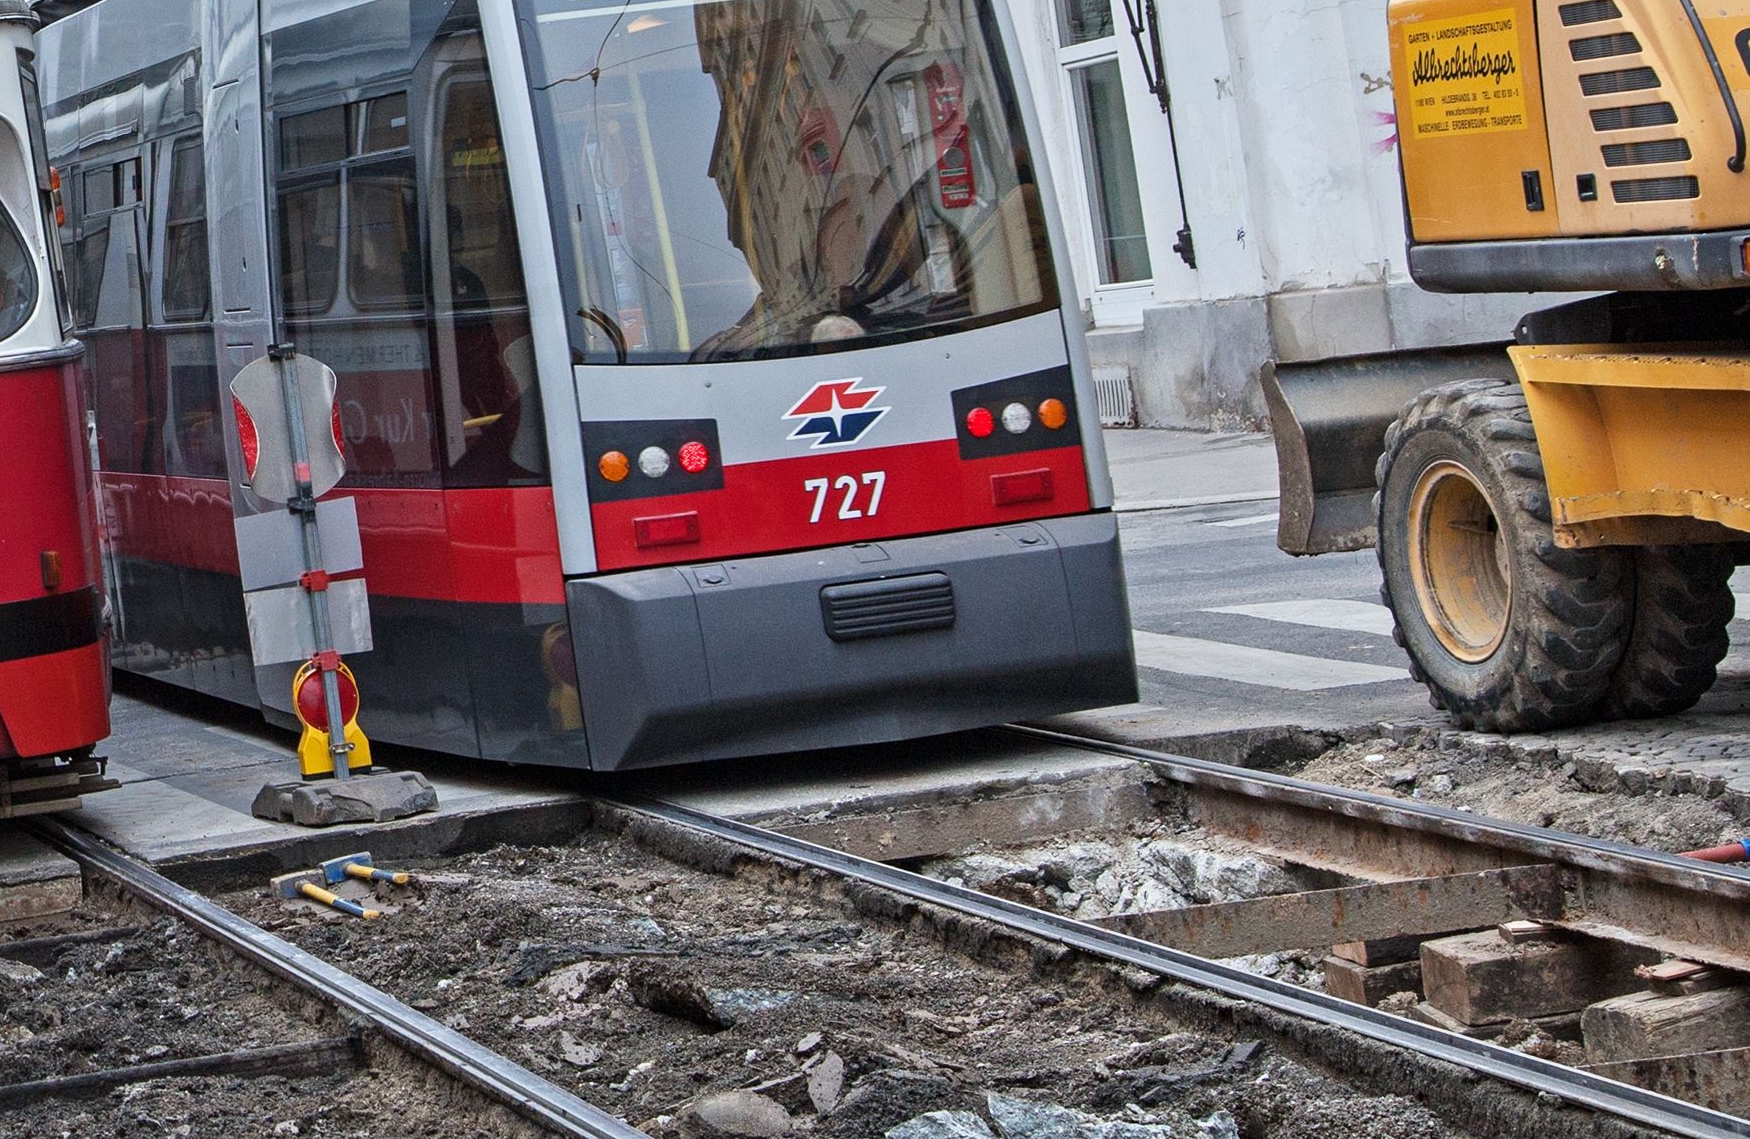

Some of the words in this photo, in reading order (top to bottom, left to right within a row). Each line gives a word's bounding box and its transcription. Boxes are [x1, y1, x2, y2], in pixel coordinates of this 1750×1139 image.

[1408, 32, 1430, 44] GARTEN
[1436, 19, 1512, 41] LANDSCHAFTSGESTALTUNG
[1413, 42, 1515, 87] Albrechtsberger
[804, 470, 886, 524] 727
